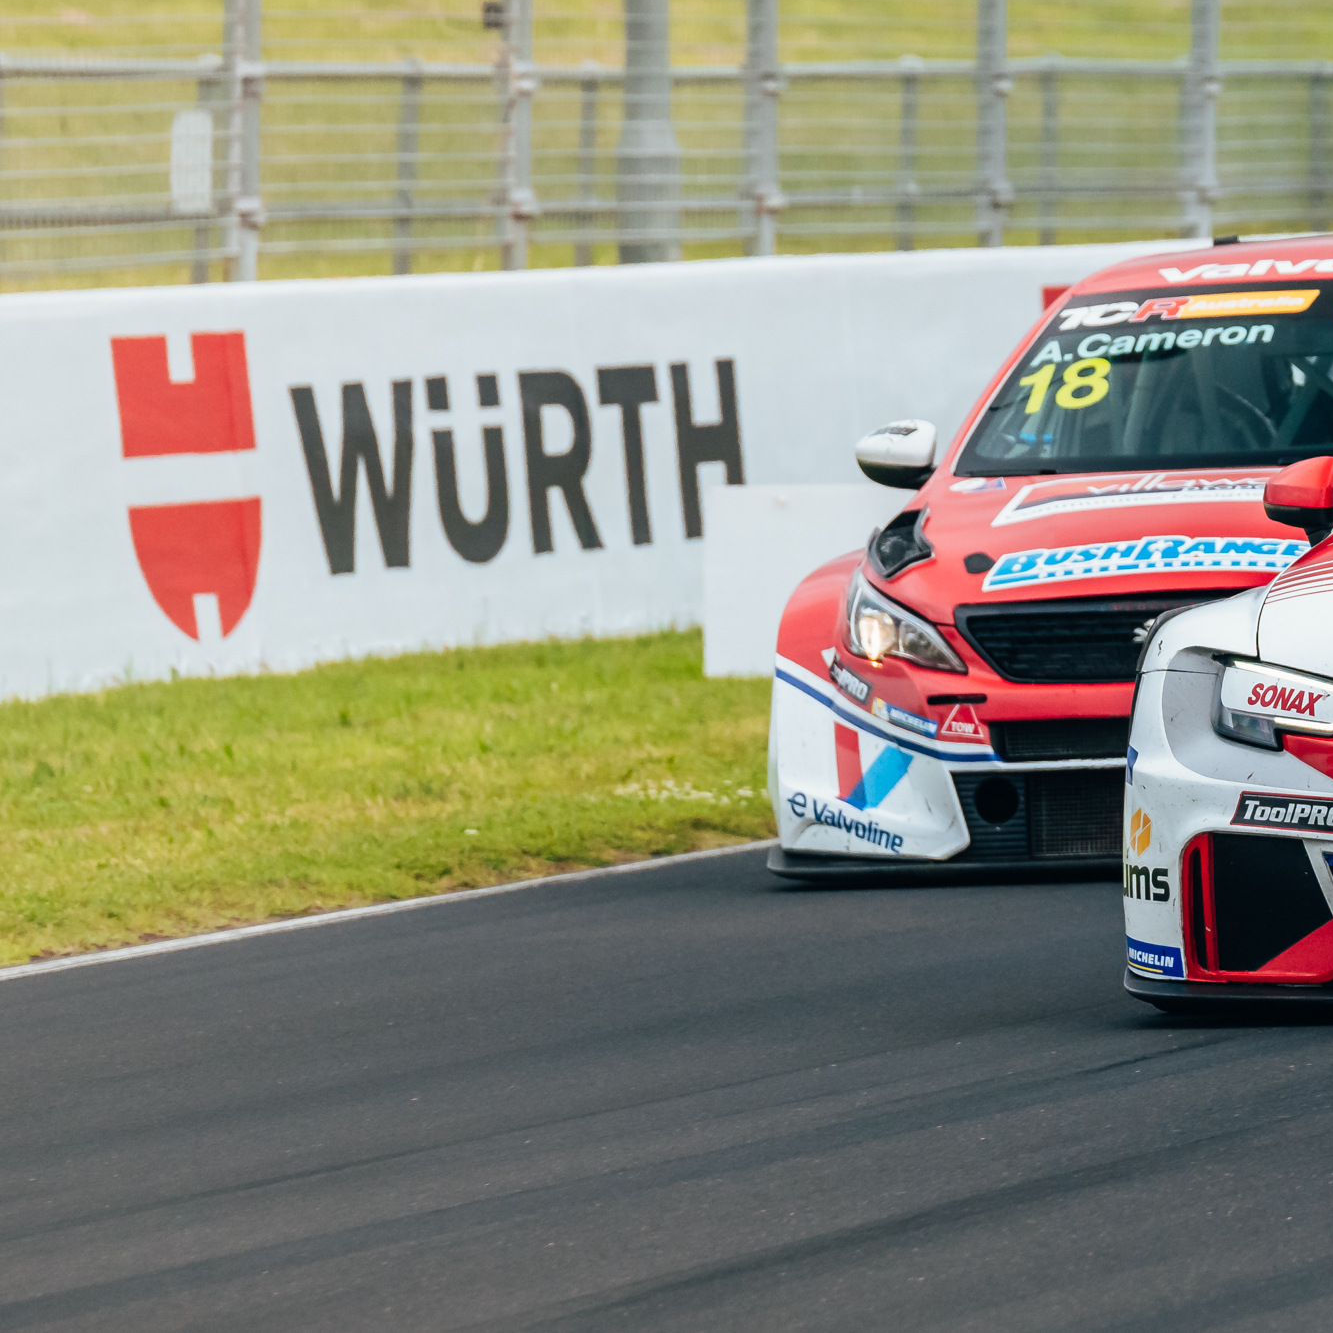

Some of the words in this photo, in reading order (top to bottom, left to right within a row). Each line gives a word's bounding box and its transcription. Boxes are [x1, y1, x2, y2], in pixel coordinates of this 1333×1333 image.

[1058, 296, 1191, 330] TCR
[1190, 293, 1306, 312] Australia
[1019, 357, 1111, 415] 18
[288, 357, 746, 576] WÜRTH
[1000, 538, 1311, 574] BUSHRANGE
[1247, 682, 1325, 717] SONAX
[951, 721, 975, 734] TOW
[812, 797, 904, 853] Valvoline
[1128, 946, 1175, 968] MICHELIN
